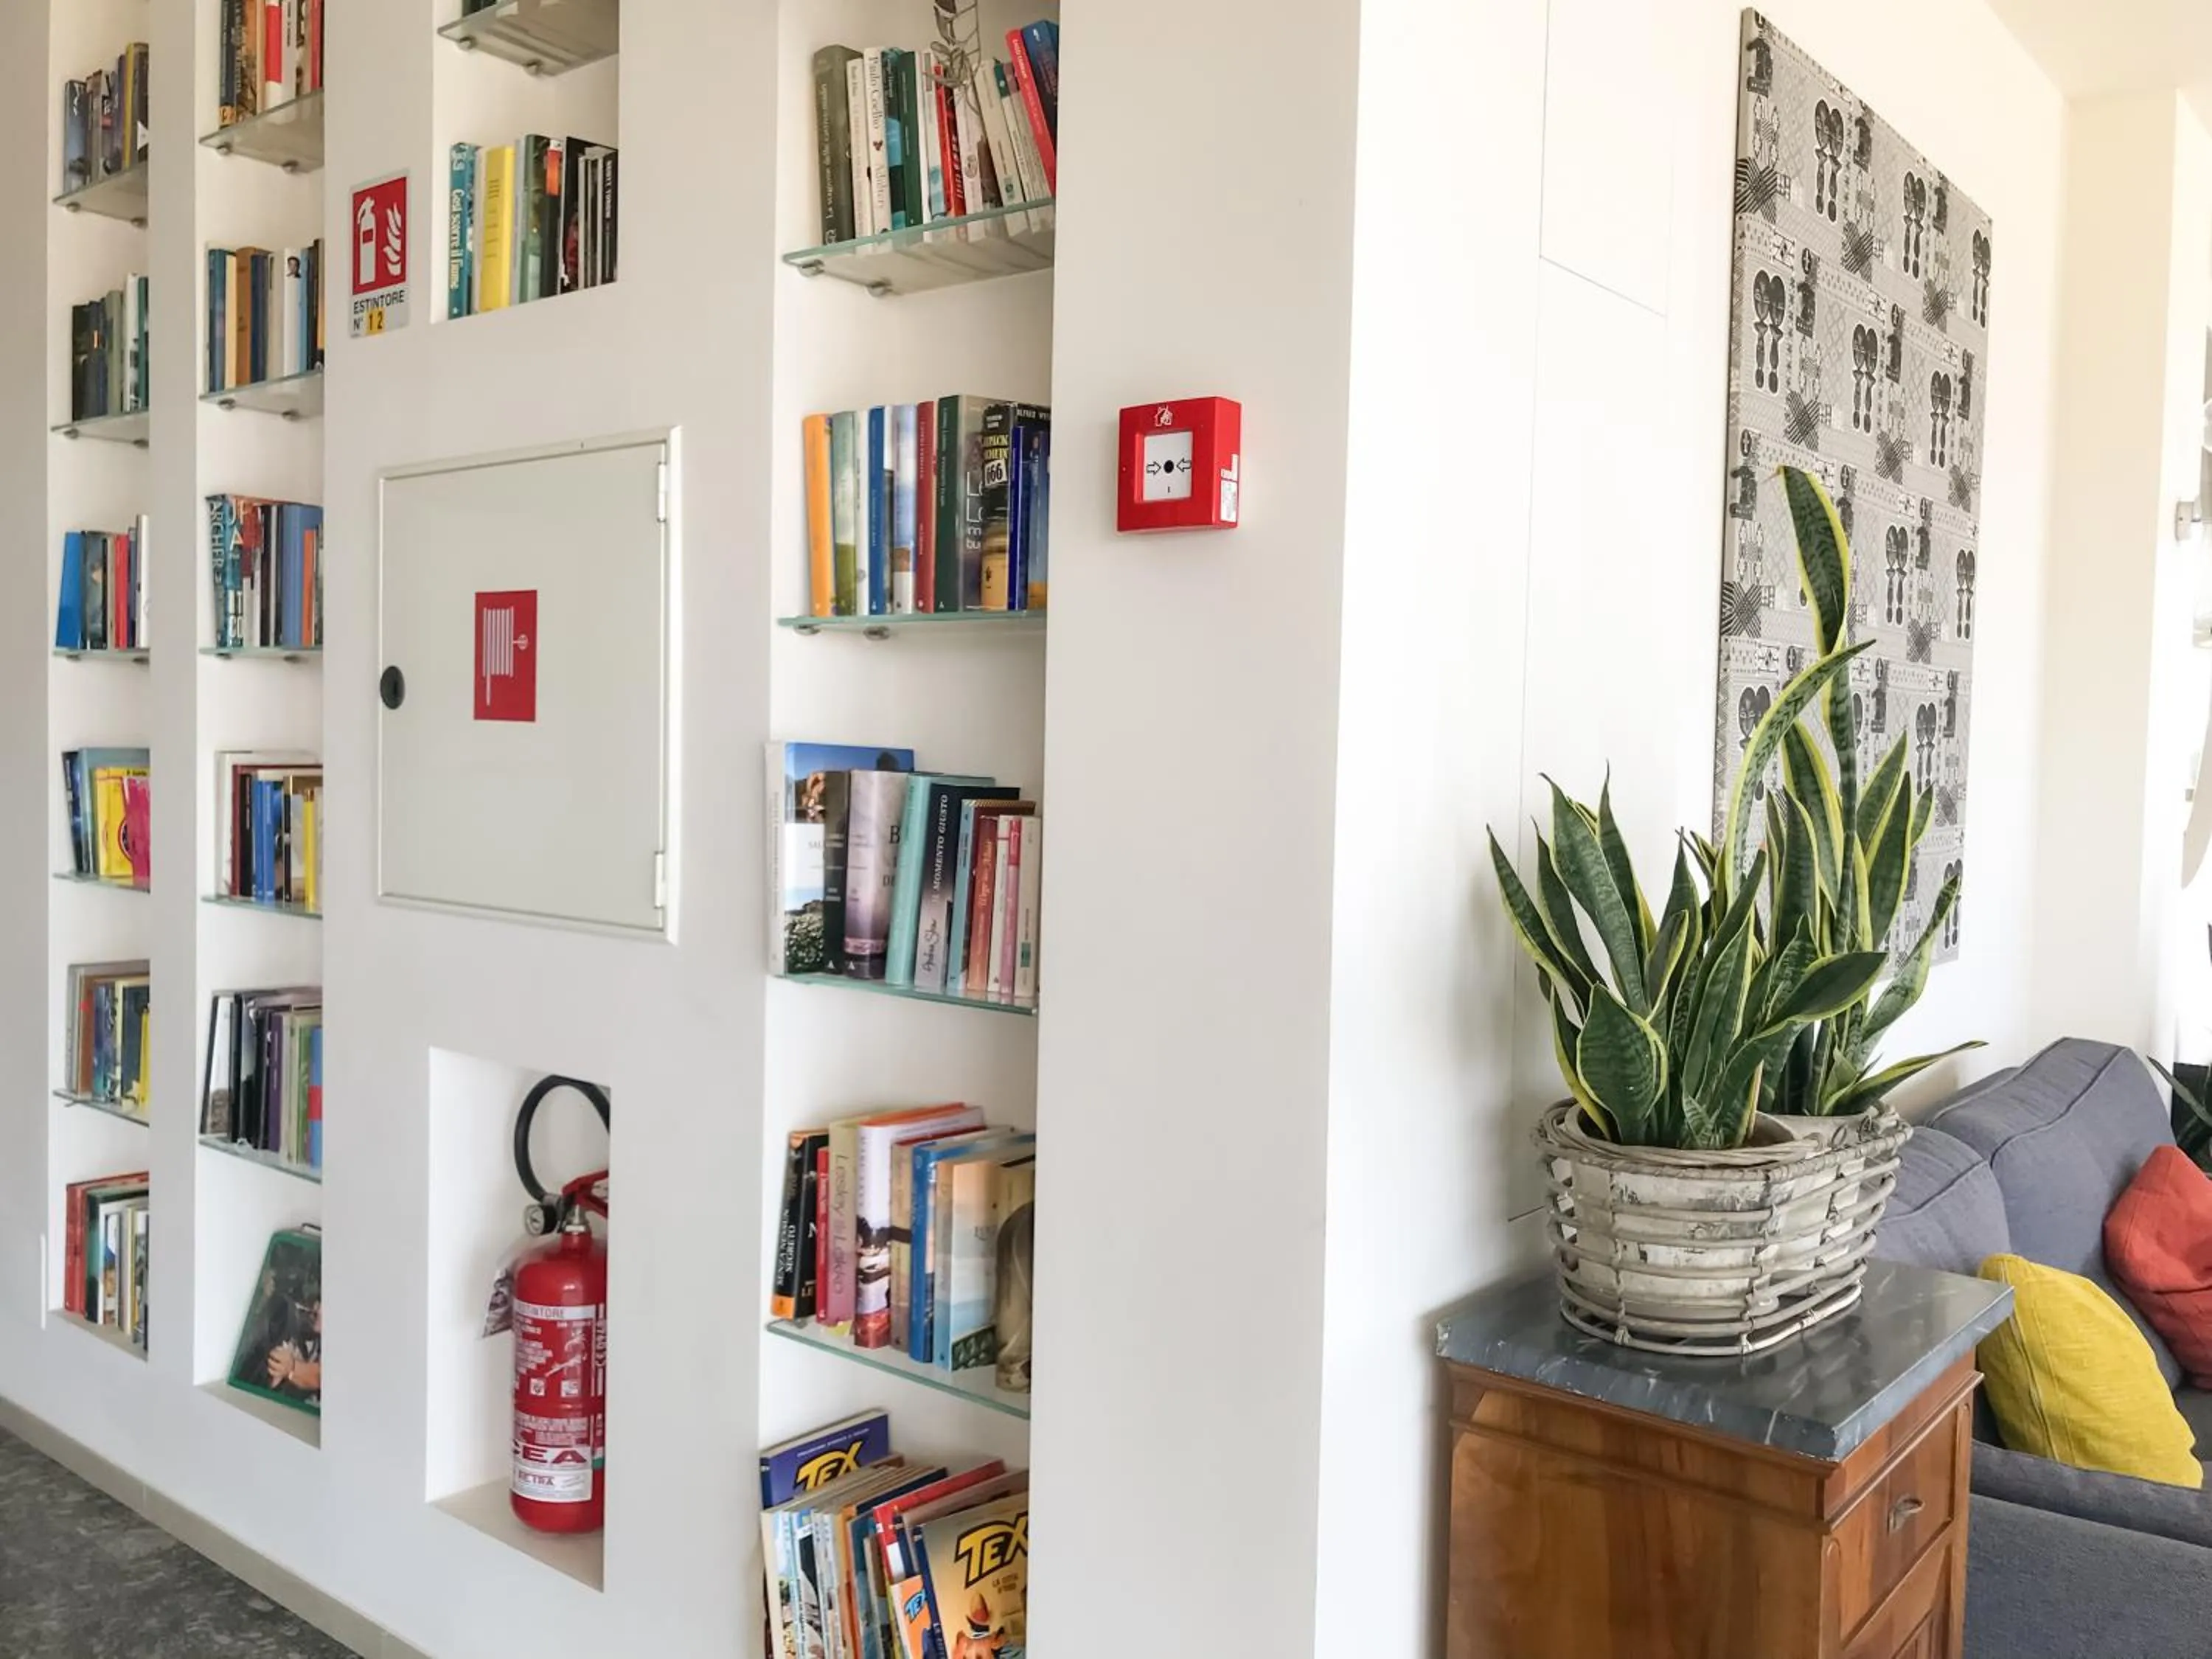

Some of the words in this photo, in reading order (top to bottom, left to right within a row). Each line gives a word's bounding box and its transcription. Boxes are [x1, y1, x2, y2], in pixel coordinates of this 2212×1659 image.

[868, 56, 879, 86] Paulo
[868, 89, 883, 129] Coelho
[354, 291, 405, 314] ESTINTORE
[210, 501, 224, 568] ARCHER
[936, 793, 950, 833] GIUSTO
[931, 835, 946, 891] MOMENTO
[793, 1439, 865, 1492] TEX
